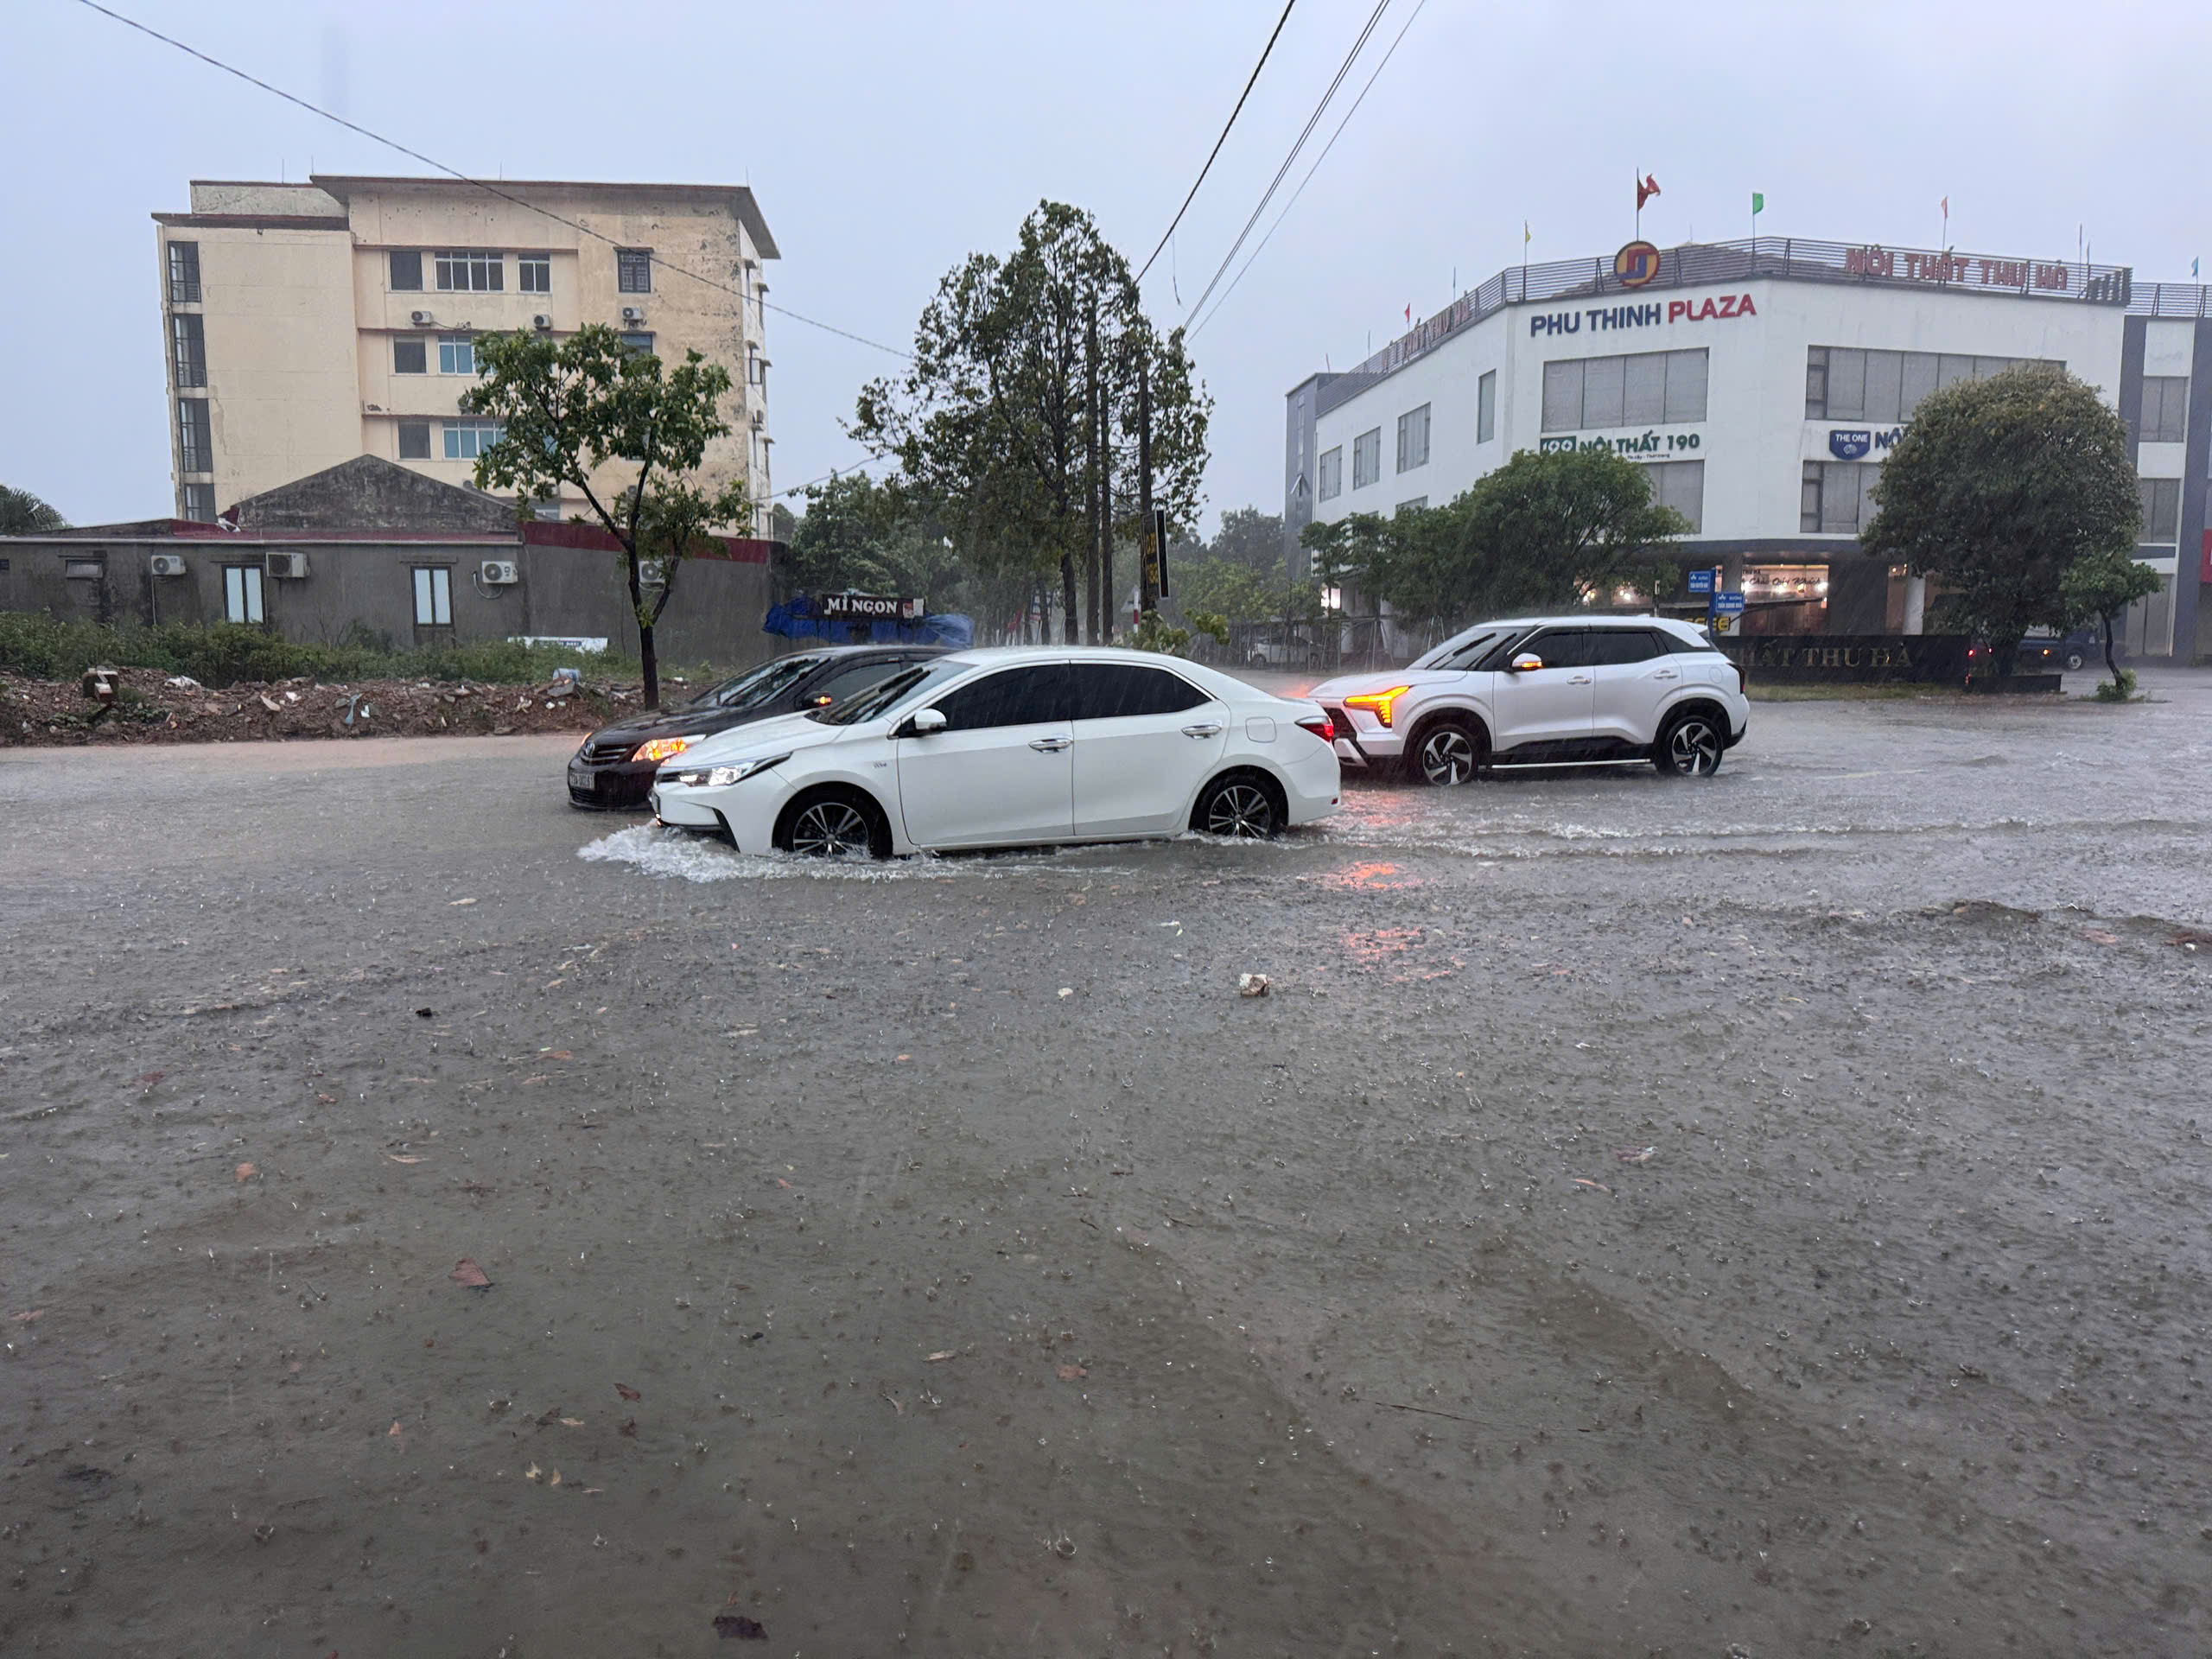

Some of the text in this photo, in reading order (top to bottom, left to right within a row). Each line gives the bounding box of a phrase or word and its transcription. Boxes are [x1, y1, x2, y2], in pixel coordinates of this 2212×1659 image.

[1904, 245, 1970, 282] THẤT
[1979, 259, 2027, 286] THU
[1530, 294, 1758, 338] PHU THINH PLAZA
[1616, 429, 1660, 454] THẤT
[1667, 434, 1700, 450] 190
[1835, 434, 1867, 443] THE ONE
[1803, 647, 1861, 668] THU
[1869, 642, 1913, 668] HÀ
